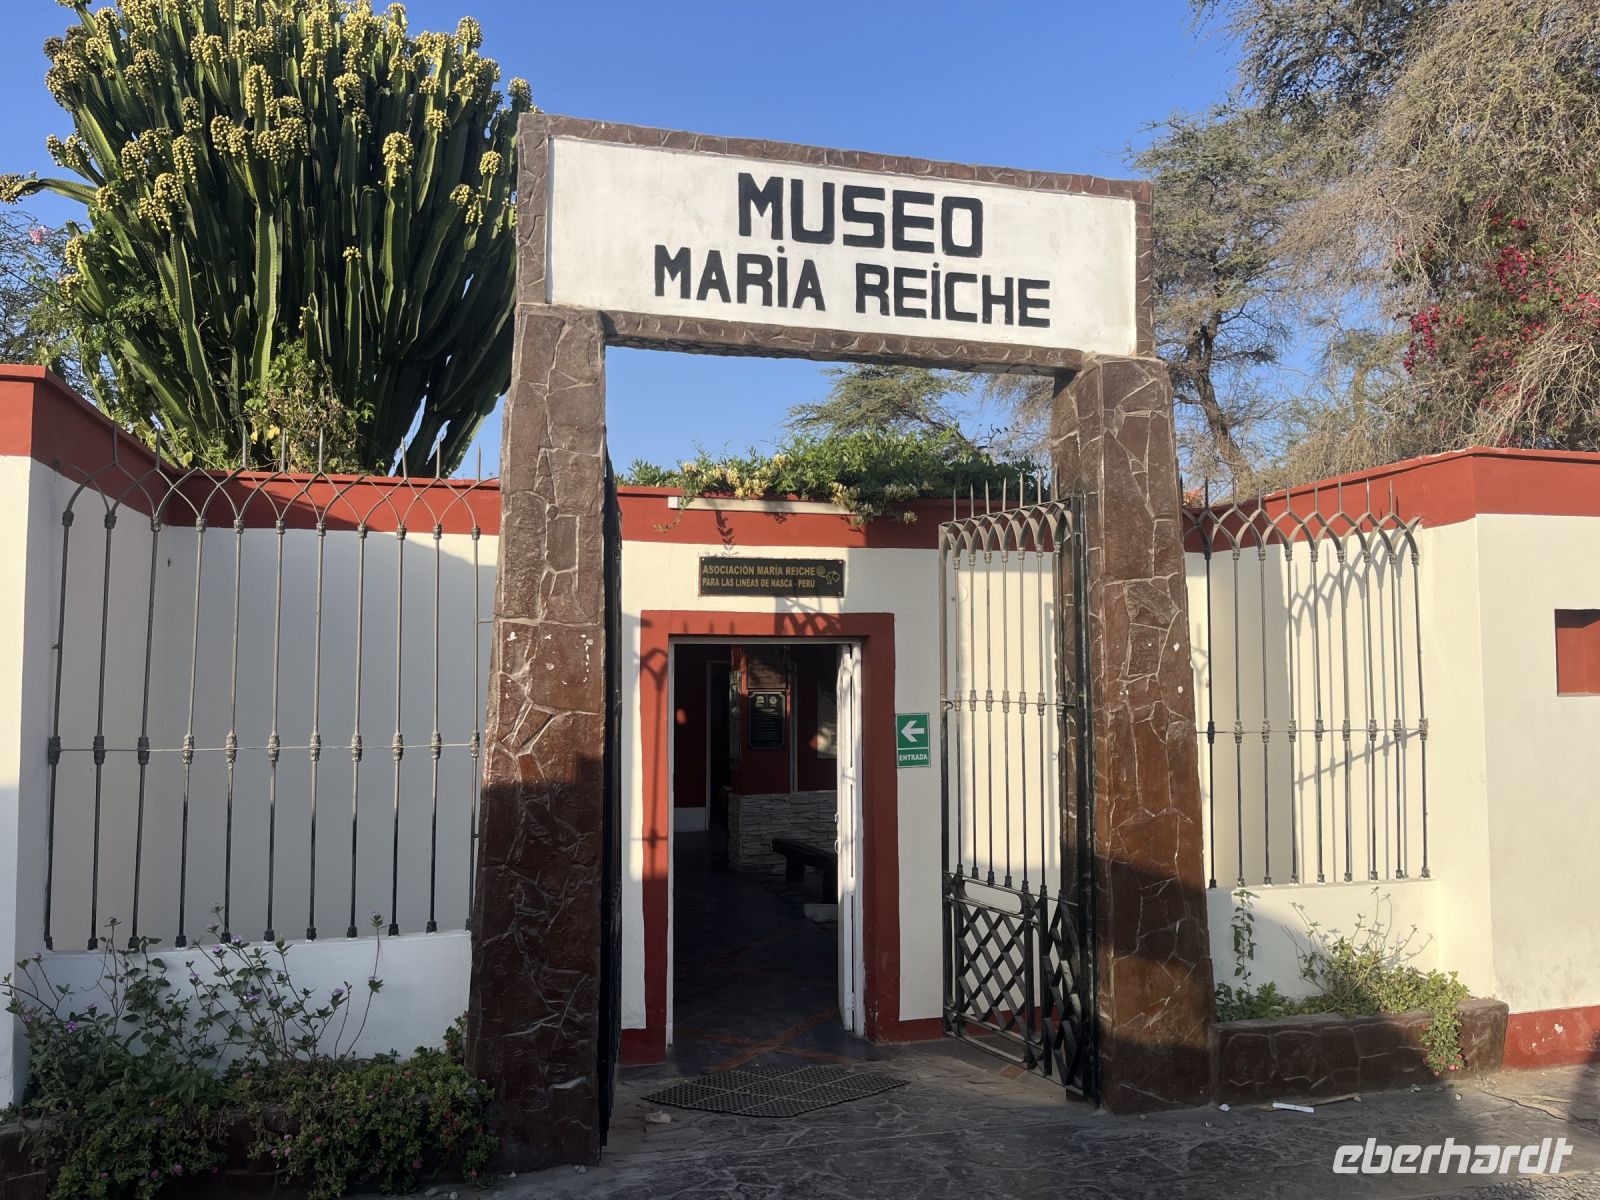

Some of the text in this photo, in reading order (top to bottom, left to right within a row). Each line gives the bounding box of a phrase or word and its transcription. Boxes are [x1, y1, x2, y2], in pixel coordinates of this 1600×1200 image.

[737, 172, 984, 258] MUSEO
[702, 563, 816, 576] ASOCIACIÓN MARÍA REICHE
[702, 578, 720, 587] PARA
[721, 579, 734, 588] LAS
[760, 579, 770, 588] DE
[770, 579, 793, 588] NASCA
